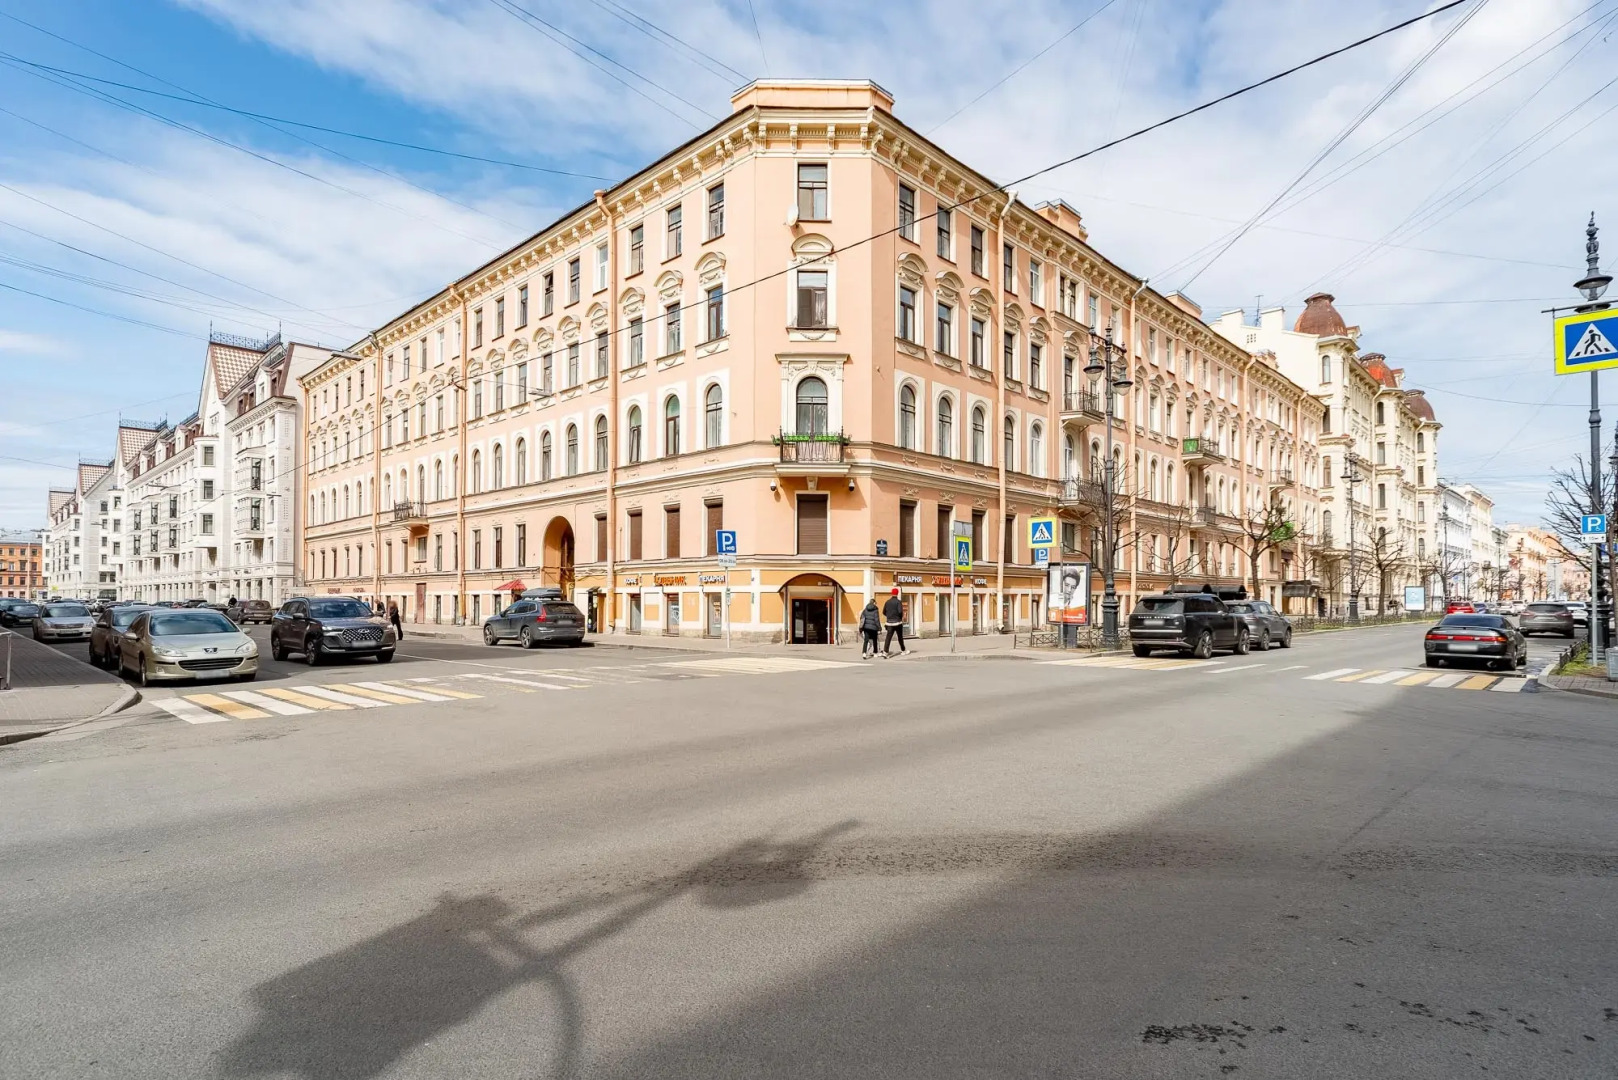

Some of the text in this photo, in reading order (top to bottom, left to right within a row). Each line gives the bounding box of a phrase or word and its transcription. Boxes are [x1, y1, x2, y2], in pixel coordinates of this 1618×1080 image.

[1587, 517, 1601, 531] P
[722, 533, 734, 551] P
[897, 575, 922, 583] ПЕКАРНЯ
